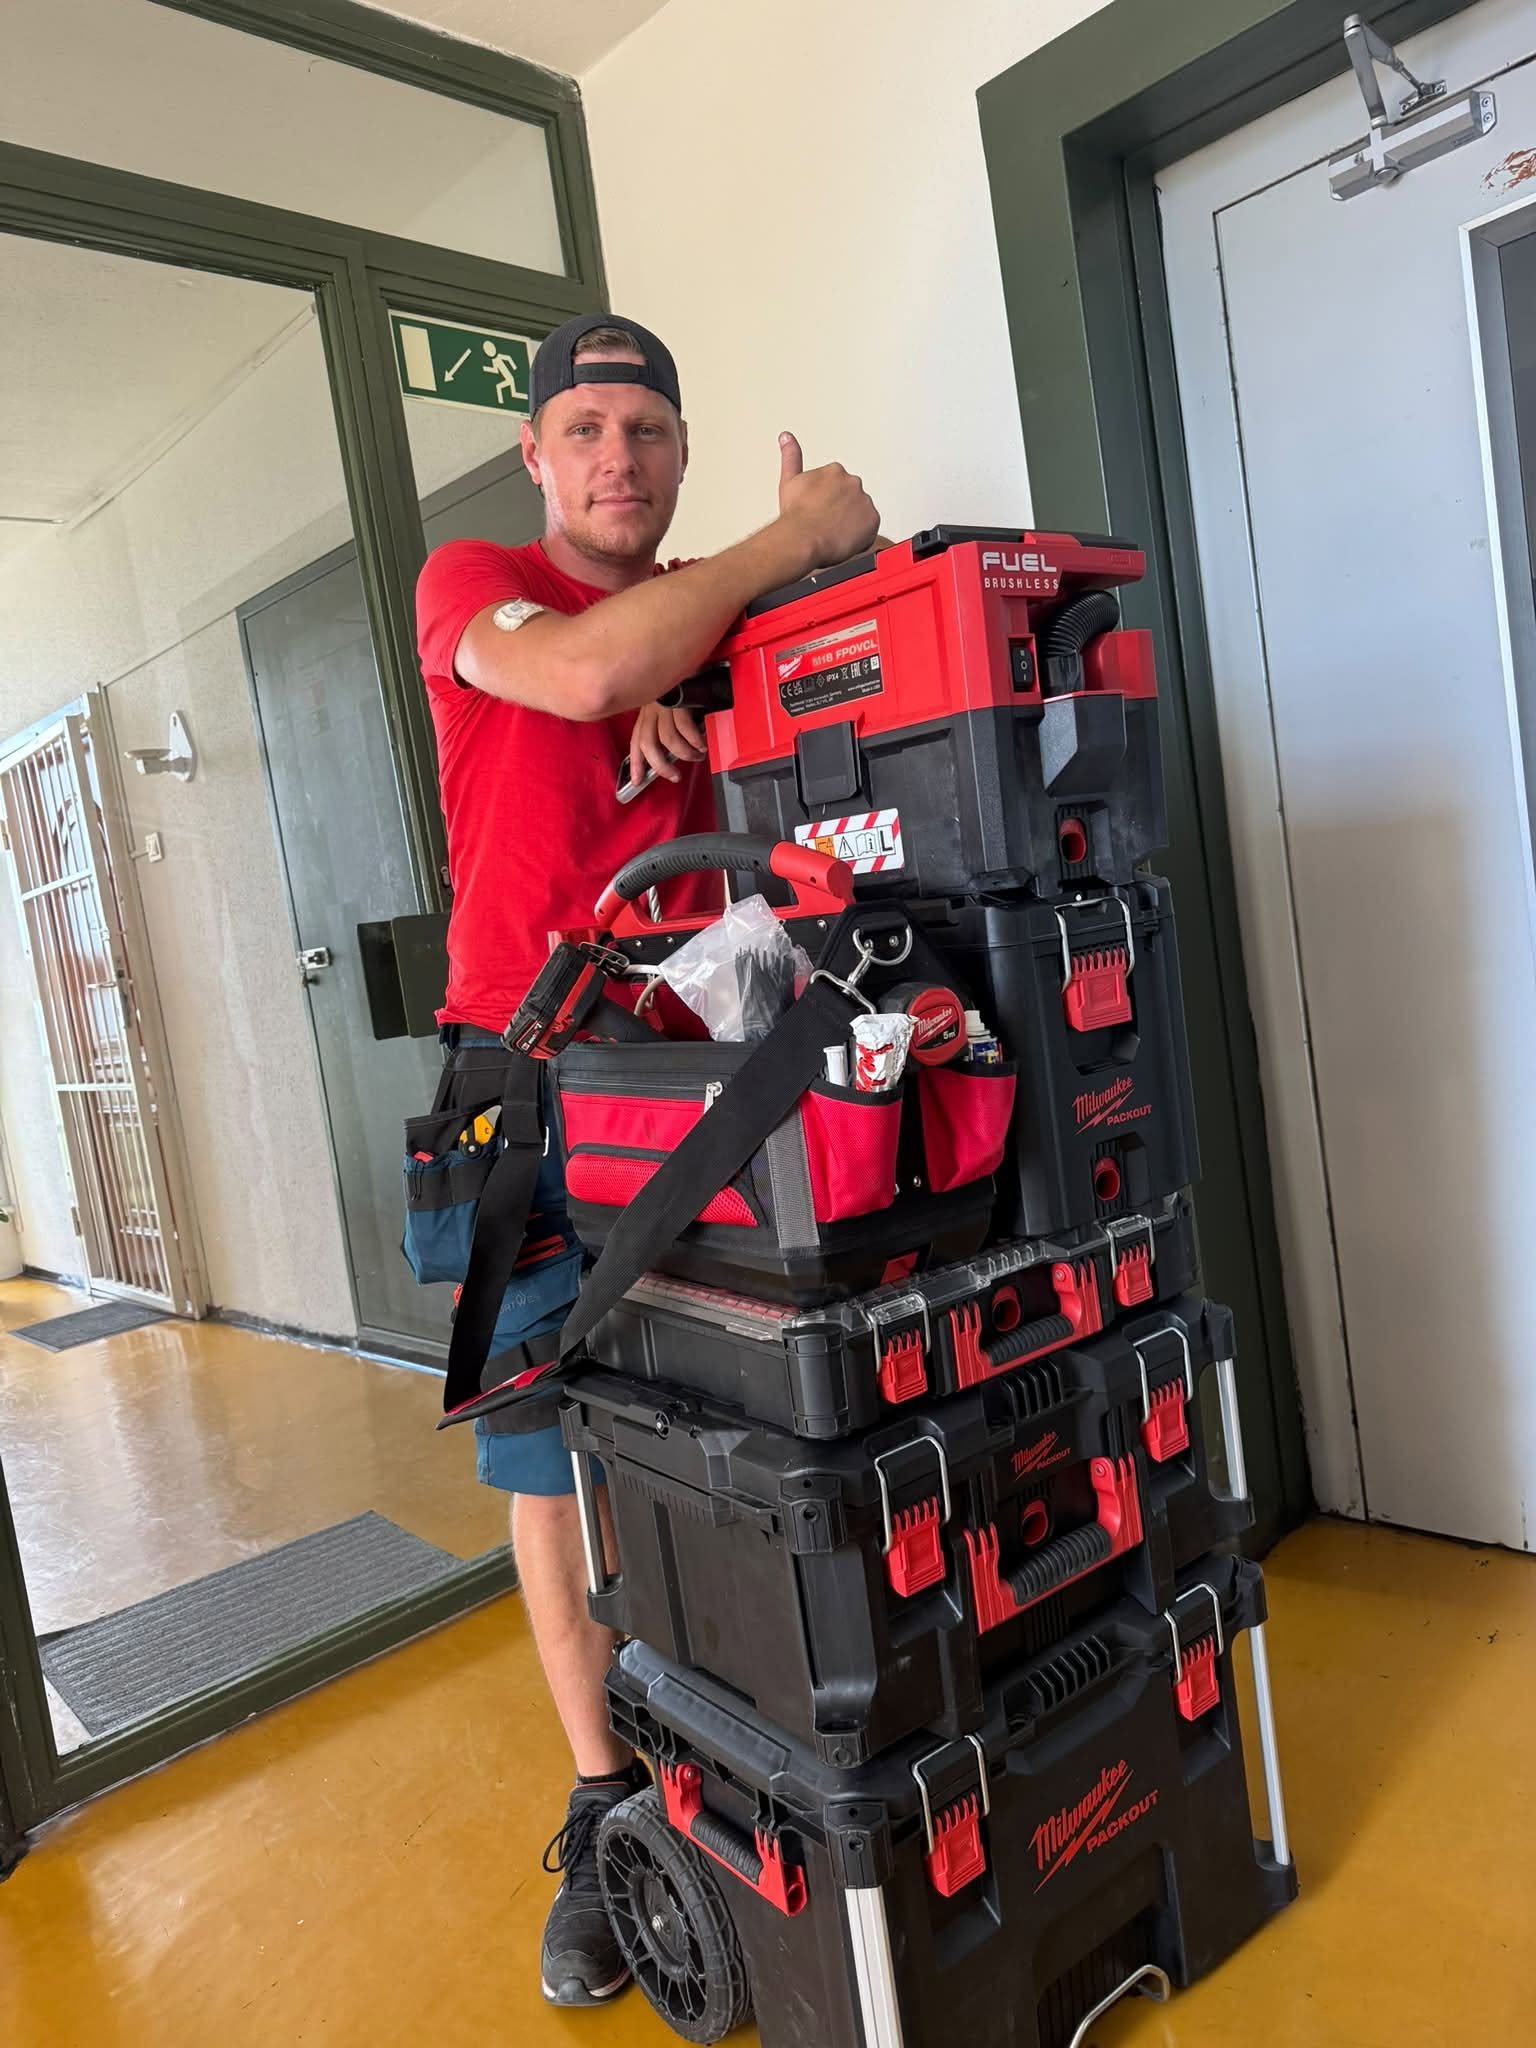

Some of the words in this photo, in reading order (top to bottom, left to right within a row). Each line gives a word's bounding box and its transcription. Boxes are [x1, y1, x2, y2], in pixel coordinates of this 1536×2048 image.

[982, 551, 1057, 573] FUEL
[984, 577, 1059, 589] BRUSHLESS
[1071, 1076, 1134, 1125] Milwaukee
[1106, 1104, 1153, 1127] PACKOUT
[1028, 1759, 1128, 1871] Milwaukee
[1086, 1789, 1159, 1855] PACKOUT
